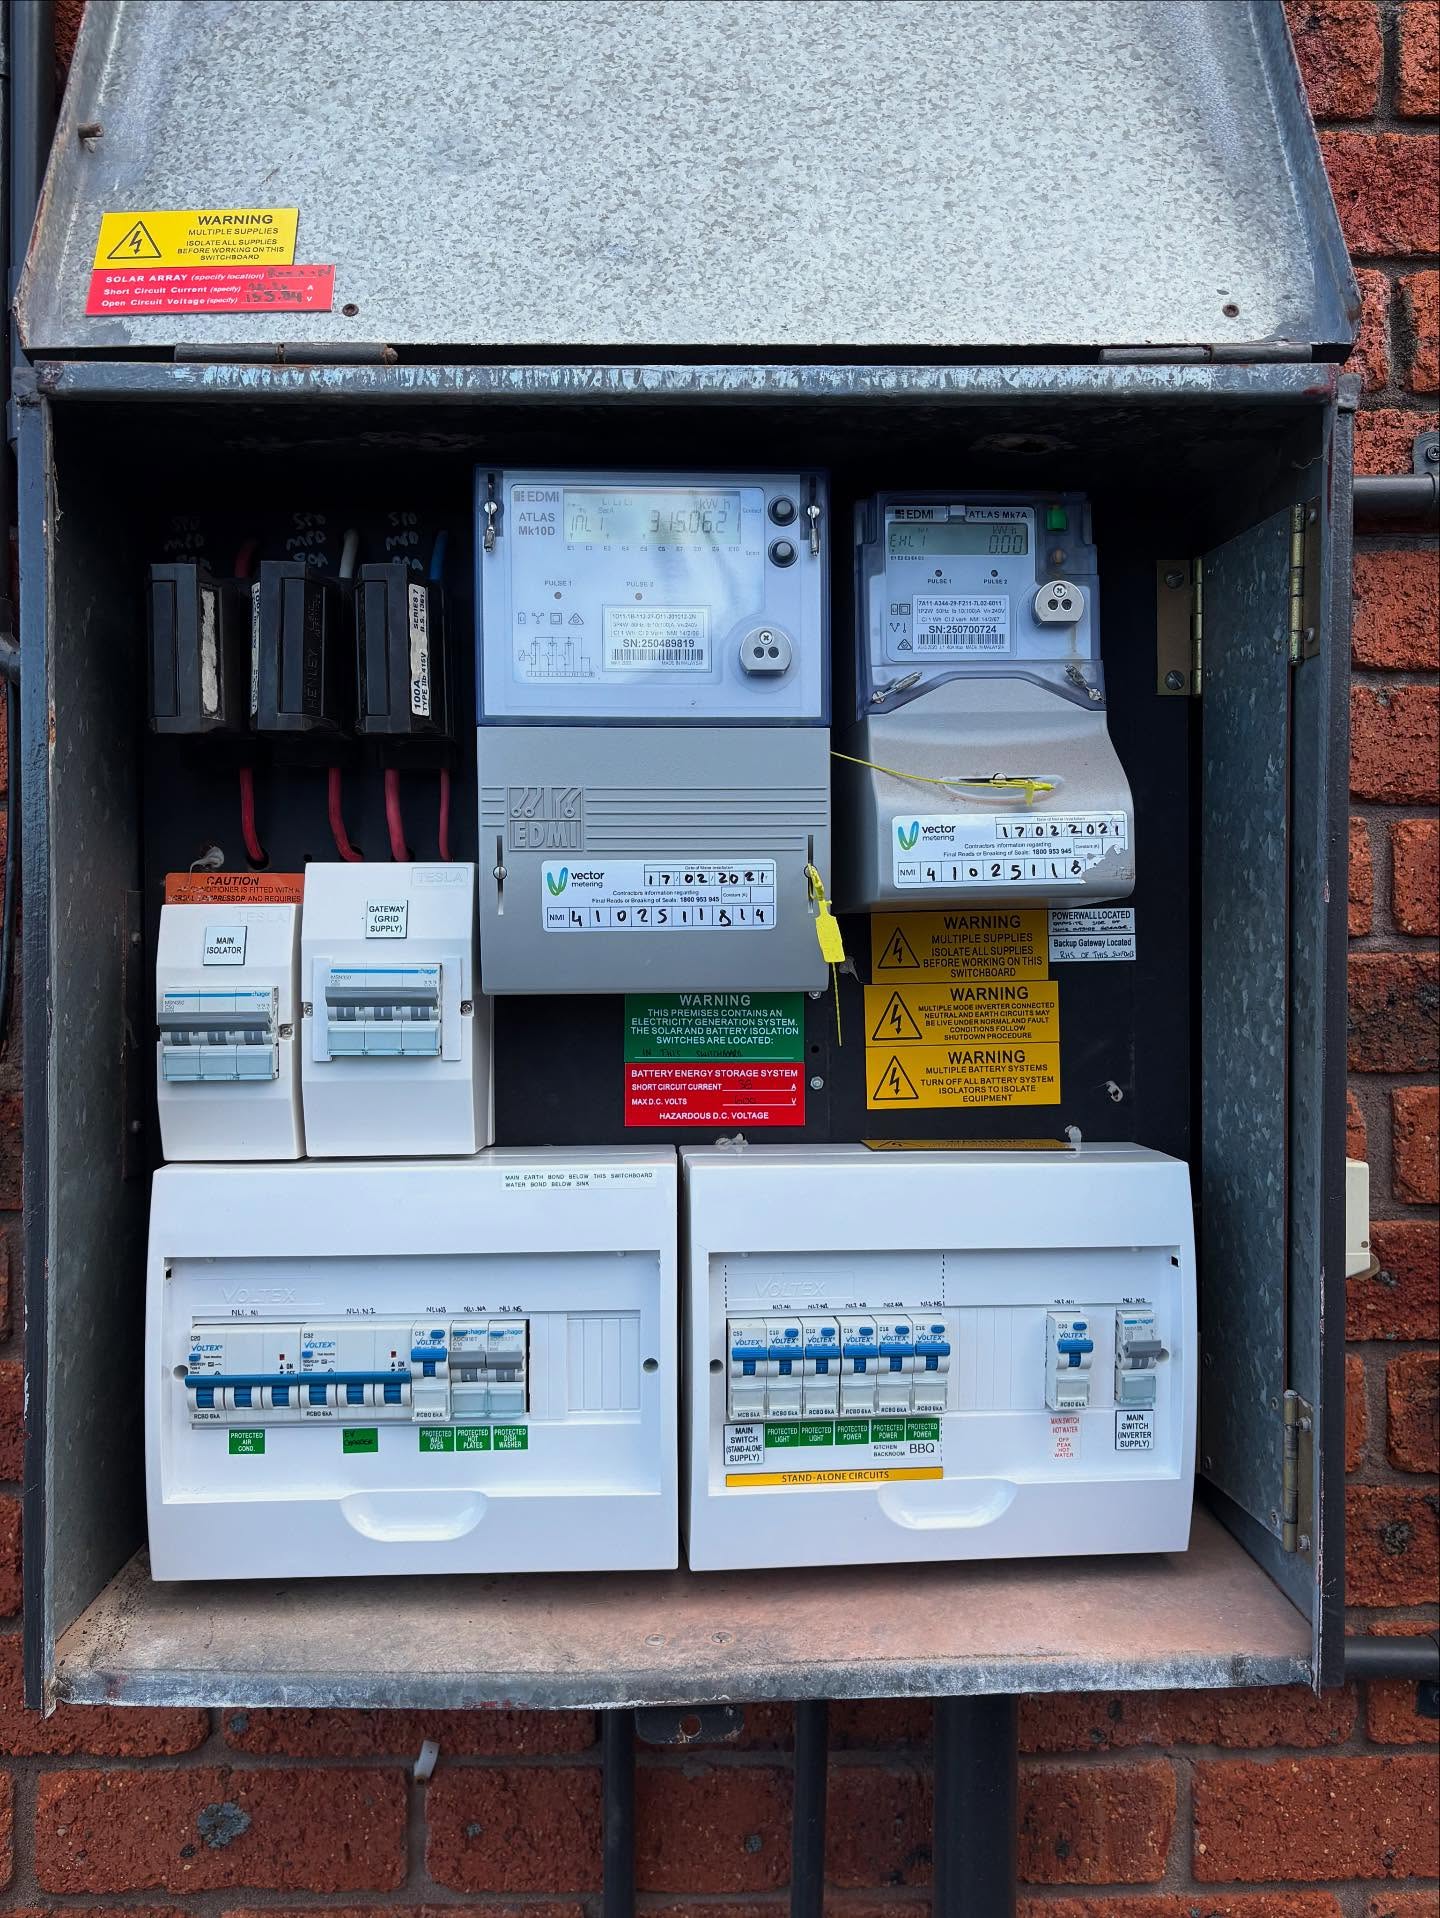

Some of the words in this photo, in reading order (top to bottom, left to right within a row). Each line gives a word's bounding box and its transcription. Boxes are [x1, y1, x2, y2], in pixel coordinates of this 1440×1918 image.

[198, 215, 273, 225] WARNING
[201, 253, 259, 261] SWITCHBOARD
[191, 274, 225, 282] (specify
[227, 272, 264, 280] location)
[210, 286, 240, 294] (specify)
[527, 491, 559, 502] EDMI
[519, 512, 555, 522] ATLAS
[907, 510, 933, 519] EDMI
[969, 511, 1000, 519] ATLAS
[1003, 511, 1028, 519] Mk7A
[519, 527, 555, 535] Mk10D
[623, 639, 694, 648] SN:250489819
[922, 825, 956, 834] vector
[514, 823, 576, 847] EDMI
[417, 872, 464, 883] TESLA
[572, 871, 604, 880] vector
[207, 877, 259, 885] CAUTION
[369, 905, 404, 913] GATEWAY
[375, 915, 399, 923] (GRID
[944, 916, 1021, 930] WARNING
[370, 925, 402, 933] SUPPLY)
[932, 934, 981, 944] MULTIPLE
[984, 933, 1033, 942] SUPPLIES
[932, 947, 970, 956] ISOLATE
[972, 947, 989, 955] ALL
[991, 946, 1033, 955] SUPPLIES
[680, 995, 750, 1006] WARNING
[948, 1050, 1025, 1064] WARNING
[756, 1281, 825, 1297] VOLTEX
[223, 1288, 295, 1303] VOLTEX
[1118, 1431, 1151, 1439] (INVERTER
[910, 1443, 934, 1453] BBQ
